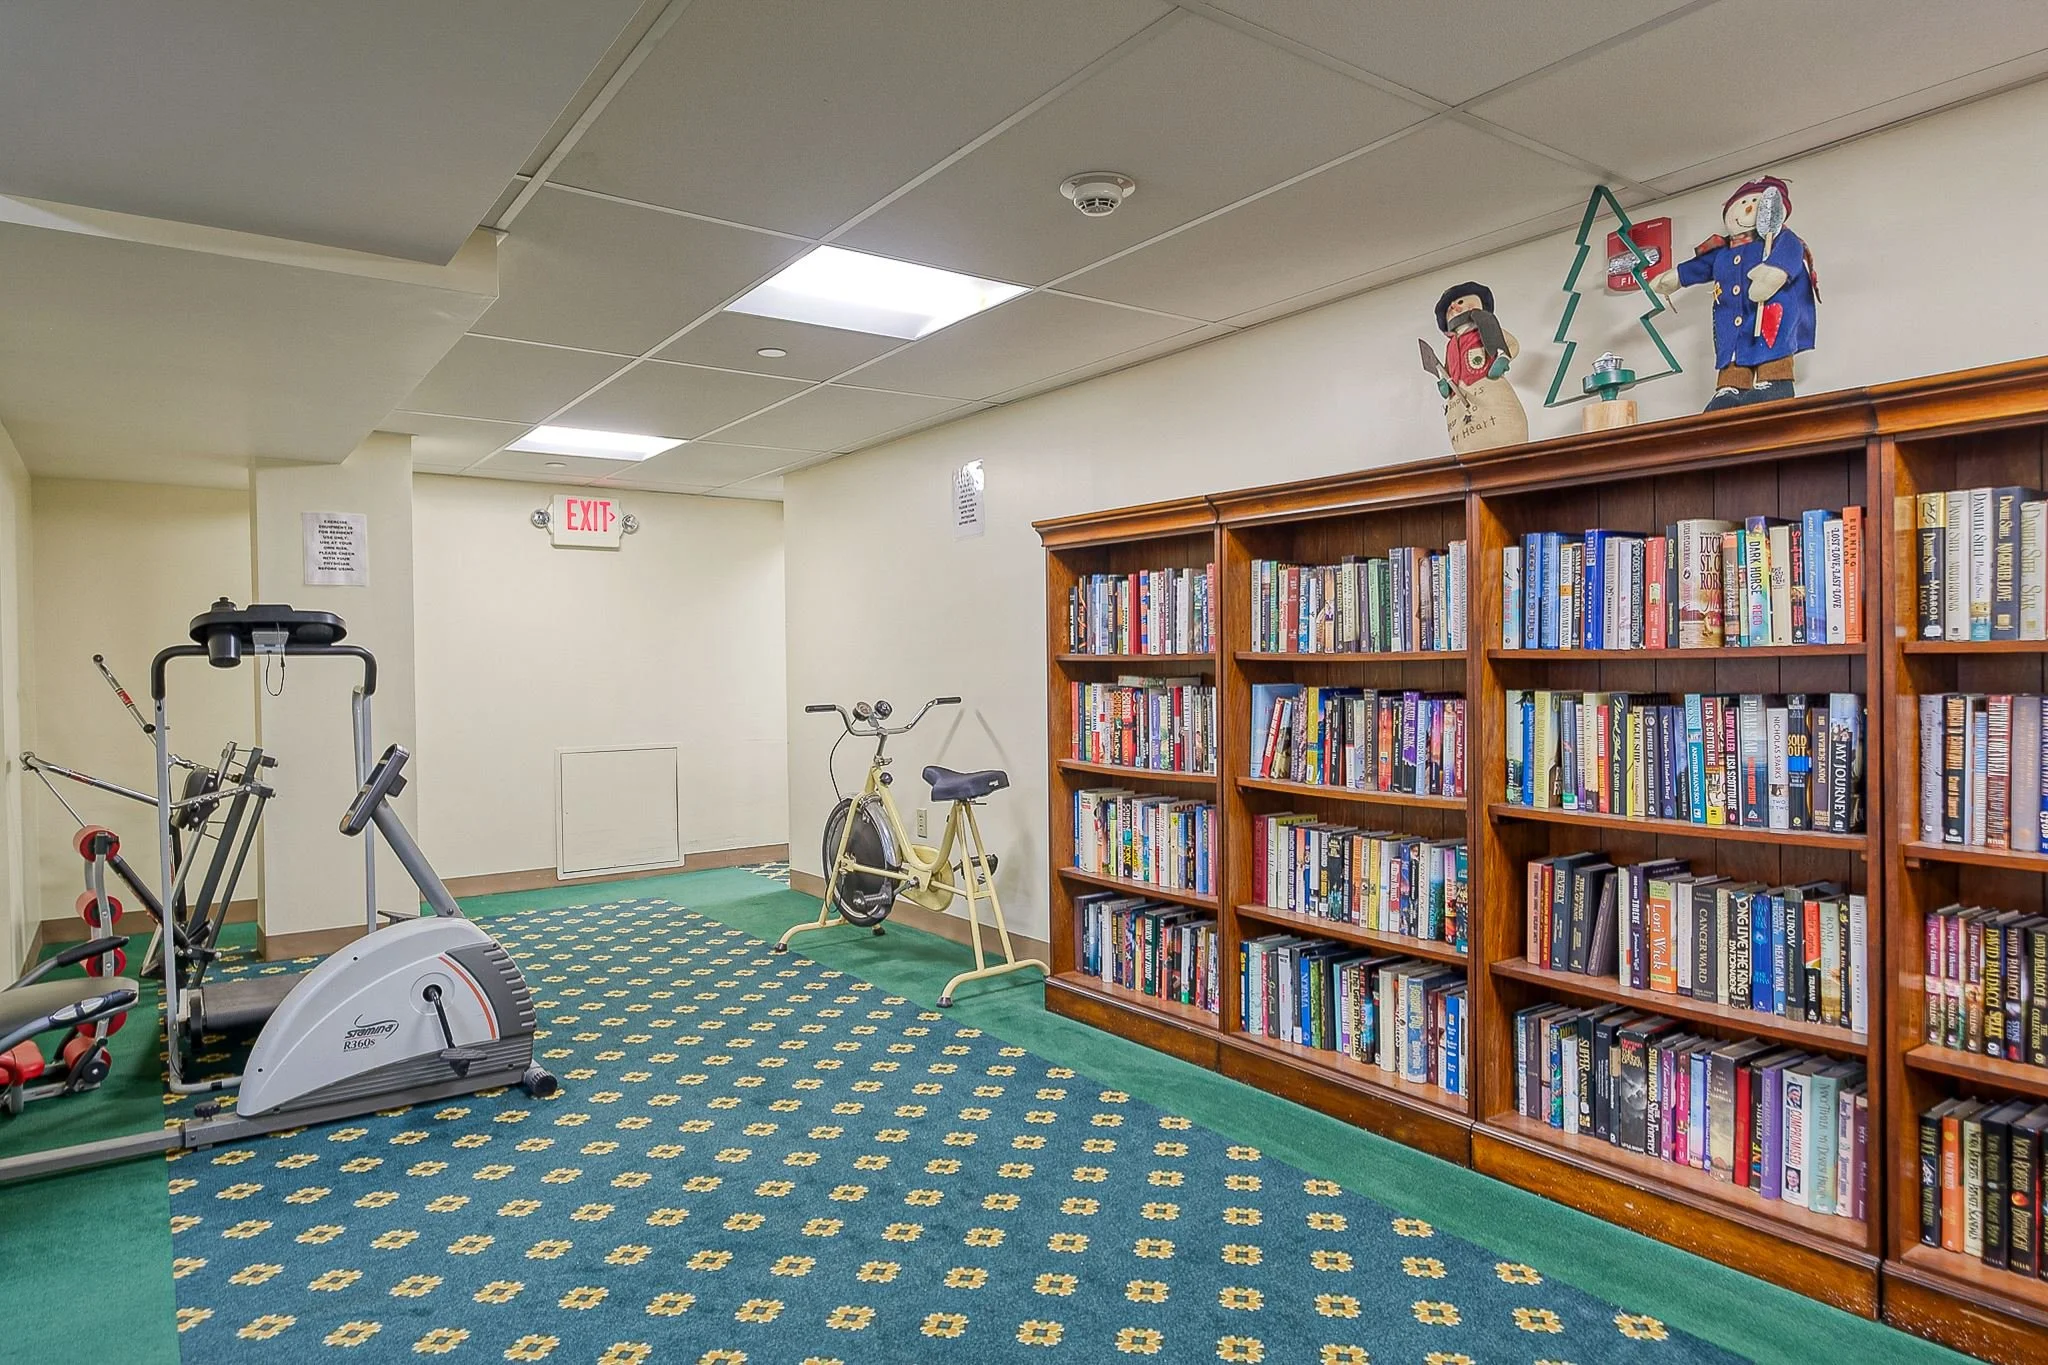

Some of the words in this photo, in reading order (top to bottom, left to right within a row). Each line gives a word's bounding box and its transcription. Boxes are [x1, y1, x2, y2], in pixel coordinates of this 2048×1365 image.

[1621, 270, 1648, 286] FIE
[1462, 415, 1496, 438] Heart
[566, 499, 611, 532] EXIT
[1700, 536, 1723, 554] LUCI
[1831, 528, 1840, 547] LOST
[1632, 543, 1641, 557] POP
[1749, 541, 1761, 564] DARK
[1632, 557, 1641, 572] GOES
[1632, 572, 1641, 583] THE
[1750, 567, 1762, 595] HORSE
[1832, 568, 1841, 587] LAST
[1632, 584, 1641, 606] WEASEL
[1832, 589, 1842, 609] LOVE
[1527, 603, 1535, 640] CHILD
[1631, 609, 1640, 642] PATTERSON
[1705, 702, 1713, 720] LISA
[1725, 711, 1734, 729] LADY
[1743, 700, 1758, 729] POLAR
[1705, 722, 1716, 766] SCOTTOLINE
[1726, 729, 1735, 752] KILLER
[1788, 734, 1807, 747] SOLD
[1788, 746, 1806, 757] OUT
[1817, 732, 1826, 760] SCREAM
[1835, 742, 1847, 760] MY
[1633, 744, 1641, 763] SHIP
[1726, 755, 1736, 770] LISA
[1774, 755, 1782, 779] SPARKS
[1613, 773, 1621, 791] SMITH
[1727, 771, 1737, 810] SCOTTOLINE
[1833, 763, 1847, 818] JOURNEY
[1557, 870, 1566, 905] BEVERLY
[1652, 903, 1666, 933] Lori
[1737, 900, 1748, 925] ONG
[1697, 908, 1708, 950] CANCER
[1737, 926, 1748, 949] LIVE
[1786, 907, 1796, 947] TUROW
[1826, 916, 1834, 942] ROAD
[1653, 937, 1668, 970] Wick
[1986, 928, 2000, 958] DAVID
[2007, 928, 2019, 956] DAVID
[2034, 933, 2046, 957] DAVID
[1737, 949, 1748, 969] THE
[1774, 944, 1784, 967] HEART
[1698, 952, 1708, 984] WARD
[1775, 967, 1784, 975] of
[2007, 957, 2019, 1000] BALDACCI
[2034, 958, 2046, 996] BALDACCI
[1737, 969, 1748, 995] KING
[1775, 976, 1785, 992] WAR
[1986, 960, 2000, 1008] BALDACCI
[1353, 989, 1361, 1007] Girls
[1353, 1009, 1361, 1017] in
[2031, 1008, 2040, 1049] COLLECTORS
[343, 1038, 376, 1050] R360s
[1648, 1048, 1657, 1074] STUART
[1648, 1074, 1658, 1102] WOODS
[1789, 1109, 1802, 1167] COMPROMISED
